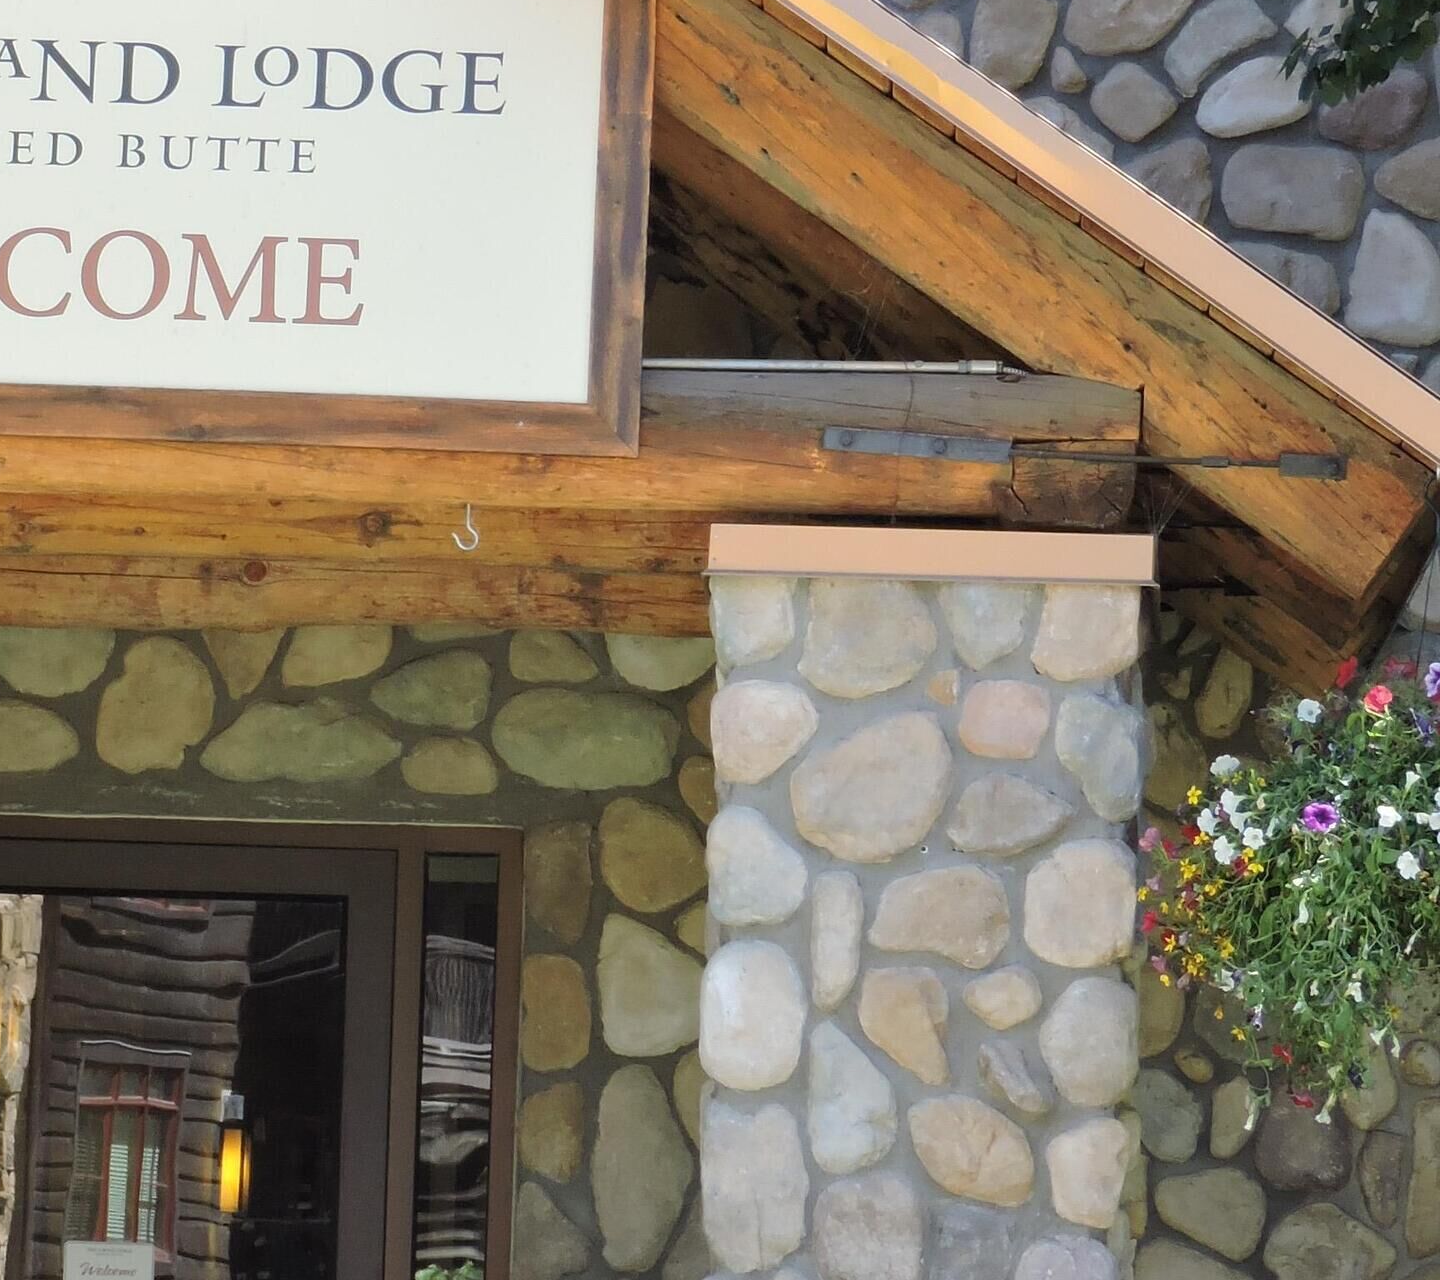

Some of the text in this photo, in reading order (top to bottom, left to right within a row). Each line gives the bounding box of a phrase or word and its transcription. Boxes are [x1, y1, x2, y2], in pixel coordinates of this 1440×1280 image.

[212, 45, 505, 114] LODGE
[118, 135, 315, 173] BUTTE
[80, 1262, 137, 1277] Welcome
